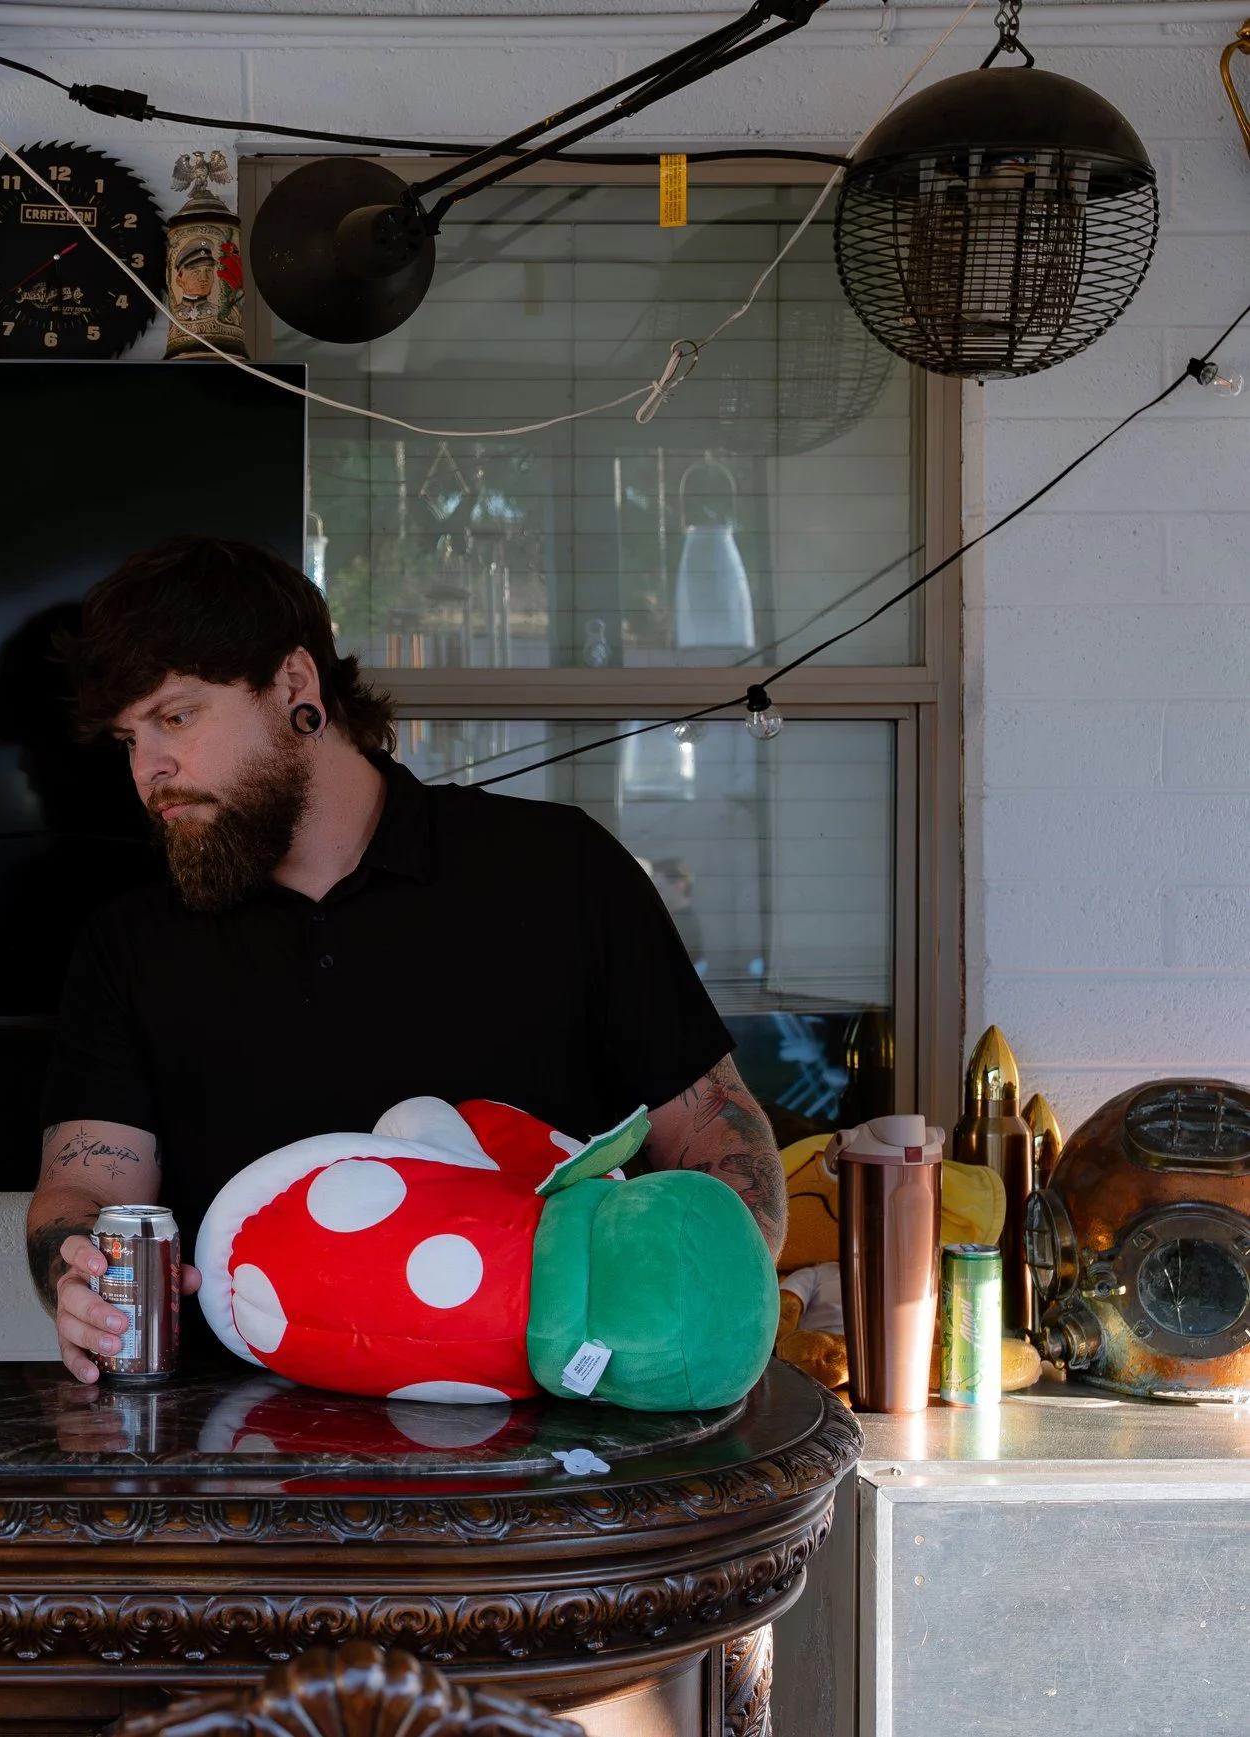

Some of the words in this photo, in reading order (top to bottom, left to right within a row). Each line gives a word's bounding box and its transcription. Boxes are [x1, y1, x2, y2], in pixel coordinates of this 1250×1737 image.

[49, 166, 71, 181] 12
[1, 175, 21, 190] 11
[95, 179, 104, 193] 1
[25, 208, 93, 222] CRAFTSMAN
[123, 213, 138, 228] 2
[131, 253, 145, 268] 3
[115, 295, 129, 309] 4
[2, 322, 15, 336] 7
[87, 327, 100, 341] 5
[44, 332, 58, 347] 6
